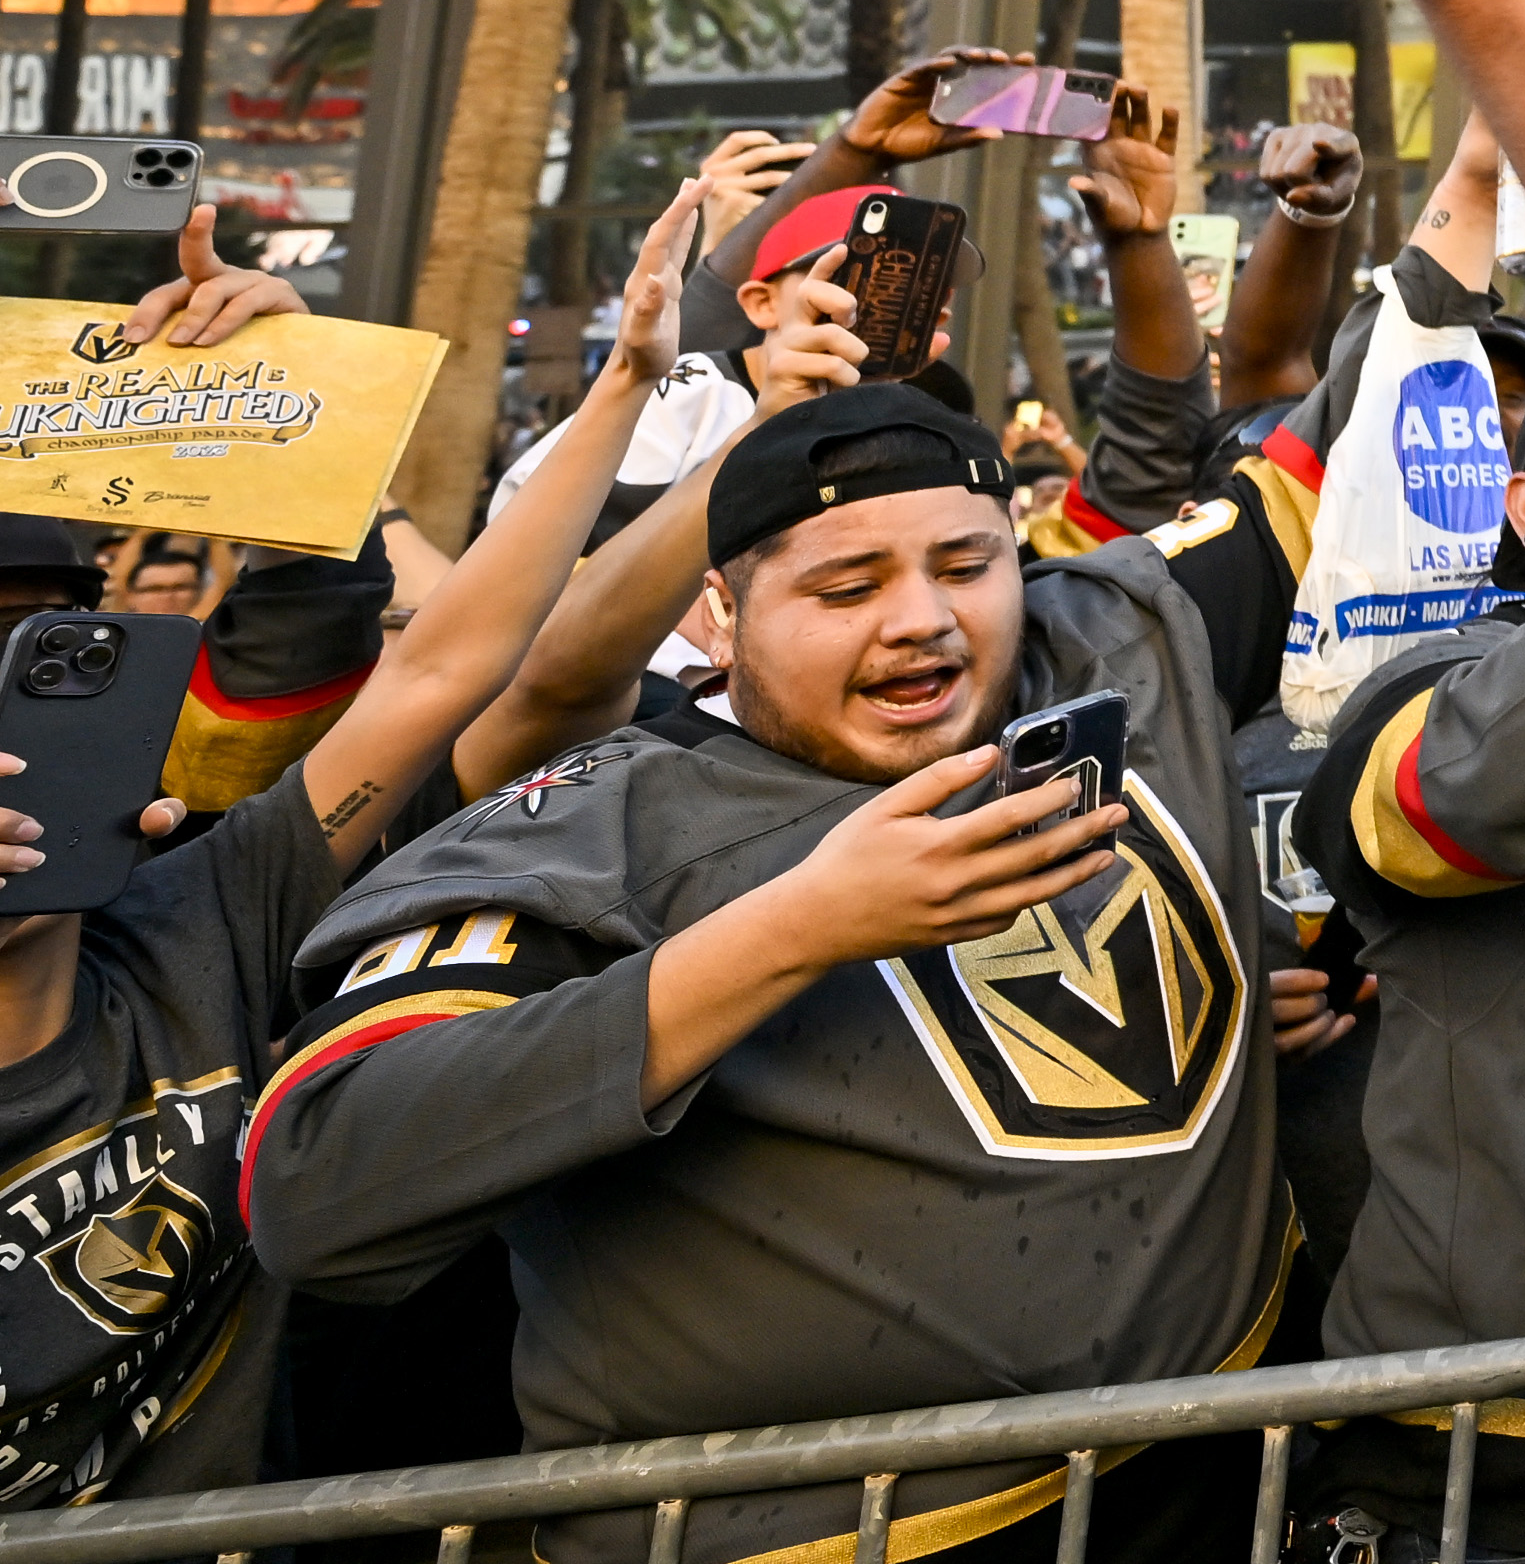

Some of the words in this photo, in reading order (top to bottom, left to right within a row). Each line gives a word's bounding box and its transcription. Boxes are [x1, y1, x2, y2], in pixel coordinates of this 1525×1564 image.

[25, 381, 70, 396] THE
[75, 361, 266, 401] REALM
[267, 367, 285, 383] IS
[1401, 404, 1504, 452] ABC
[171, 443, 229, 459] 2023
[1407, 462, 1510, 490] STORES
[1409, 544, 1452, 572] LAS
